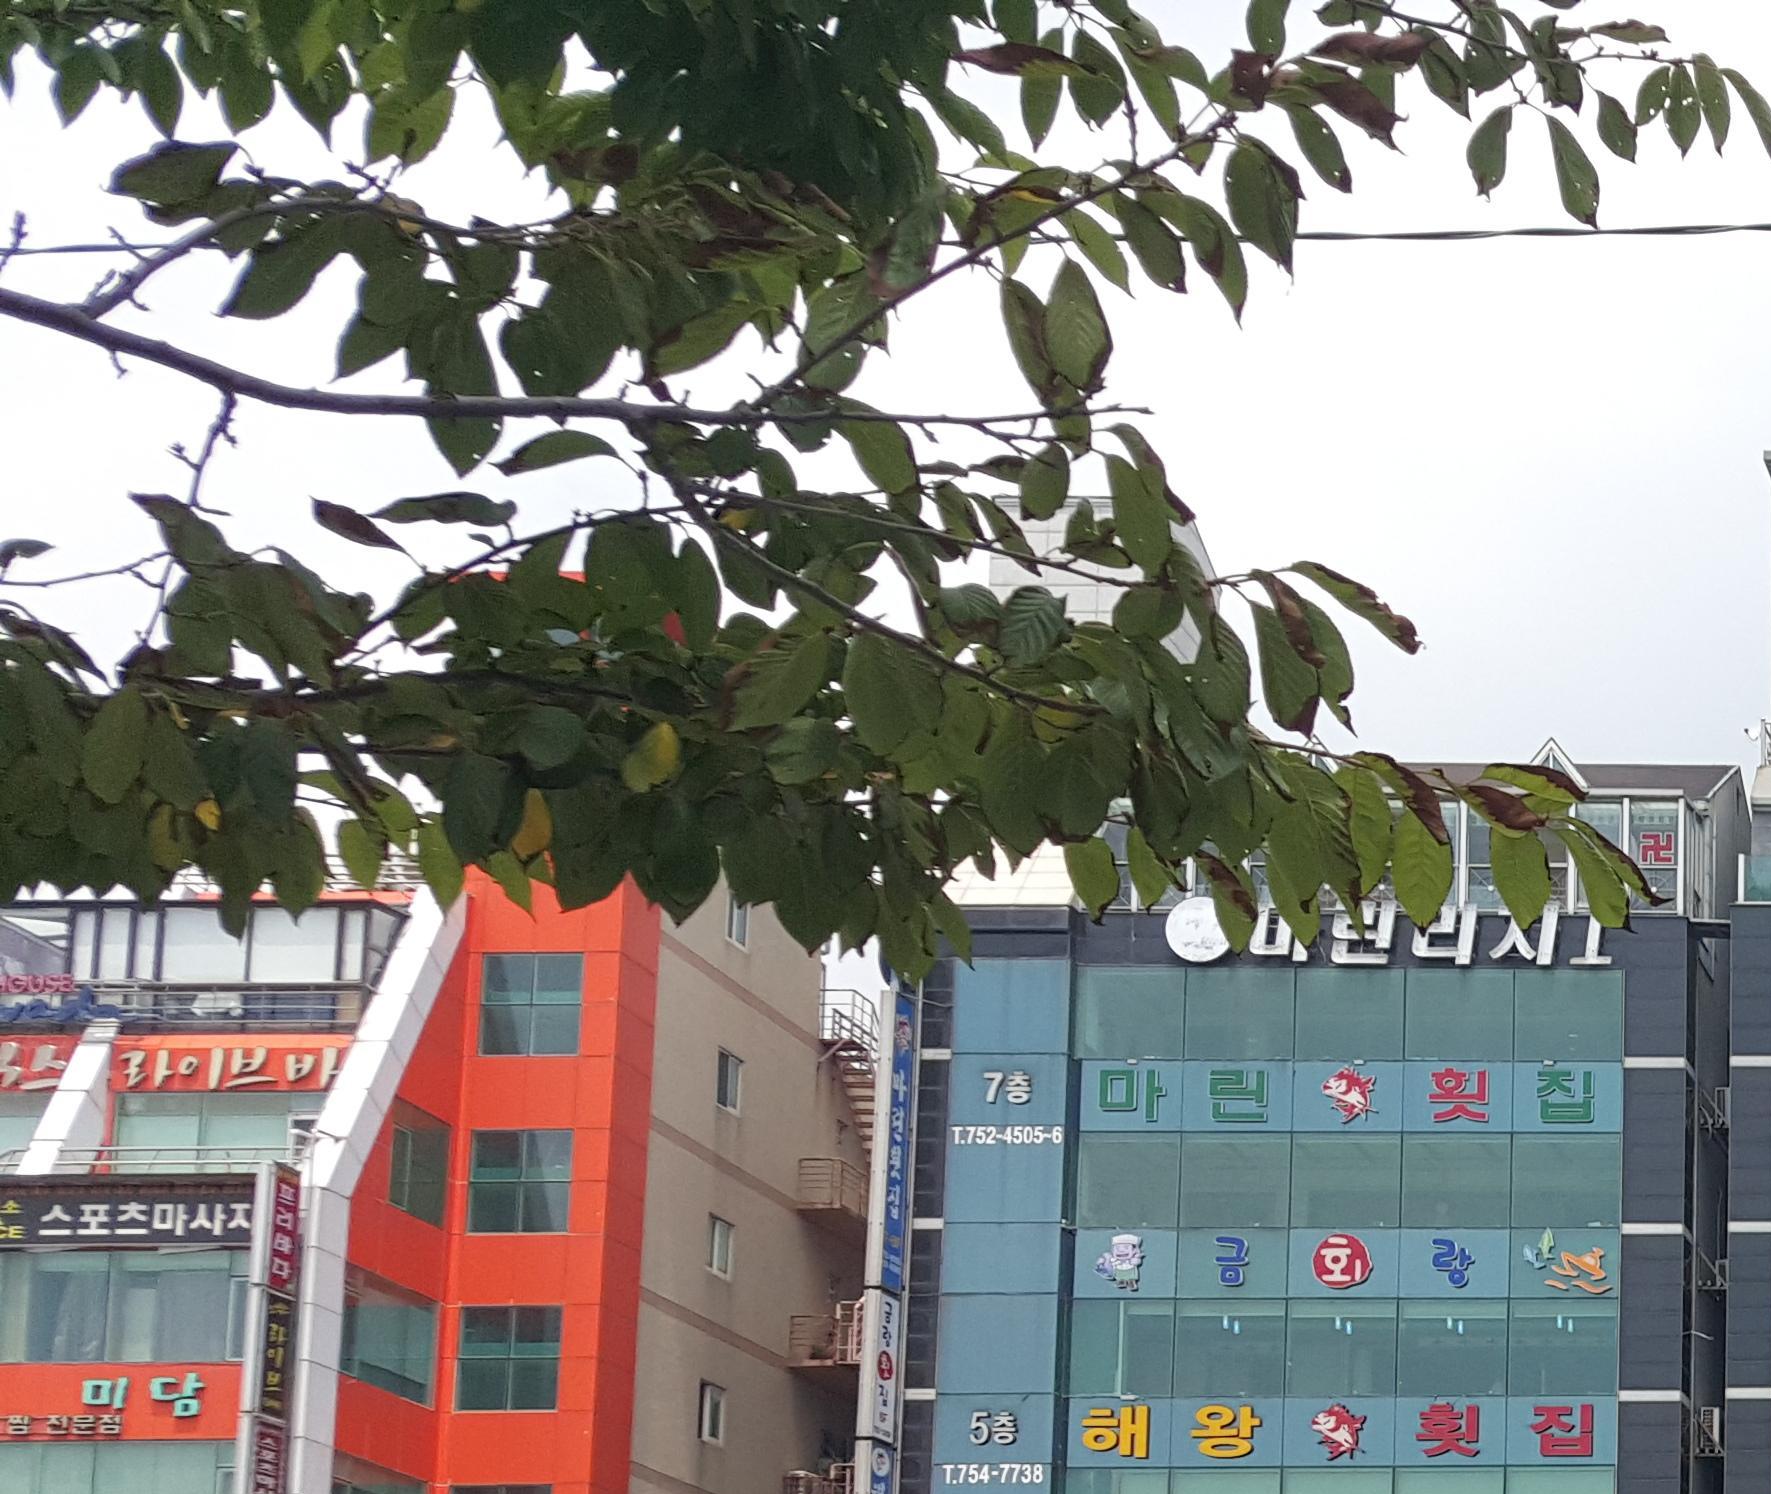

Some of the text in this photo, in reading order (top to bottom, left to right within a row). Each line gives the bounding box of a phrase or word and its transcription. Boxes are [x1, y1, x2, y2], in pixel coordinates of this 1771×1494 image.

[983, 1071, 1032, 1105] 7층
[1098, 1066, 1595, 1124] 마린 횟집
[82, 1373, 206, 1417] 미담
[968, 1412, 1018, 1446] 5층
[1082, 1403, 1593, 1459] 해왕 횟집
[943, 1465, 1043, 1485] T.754-7738
